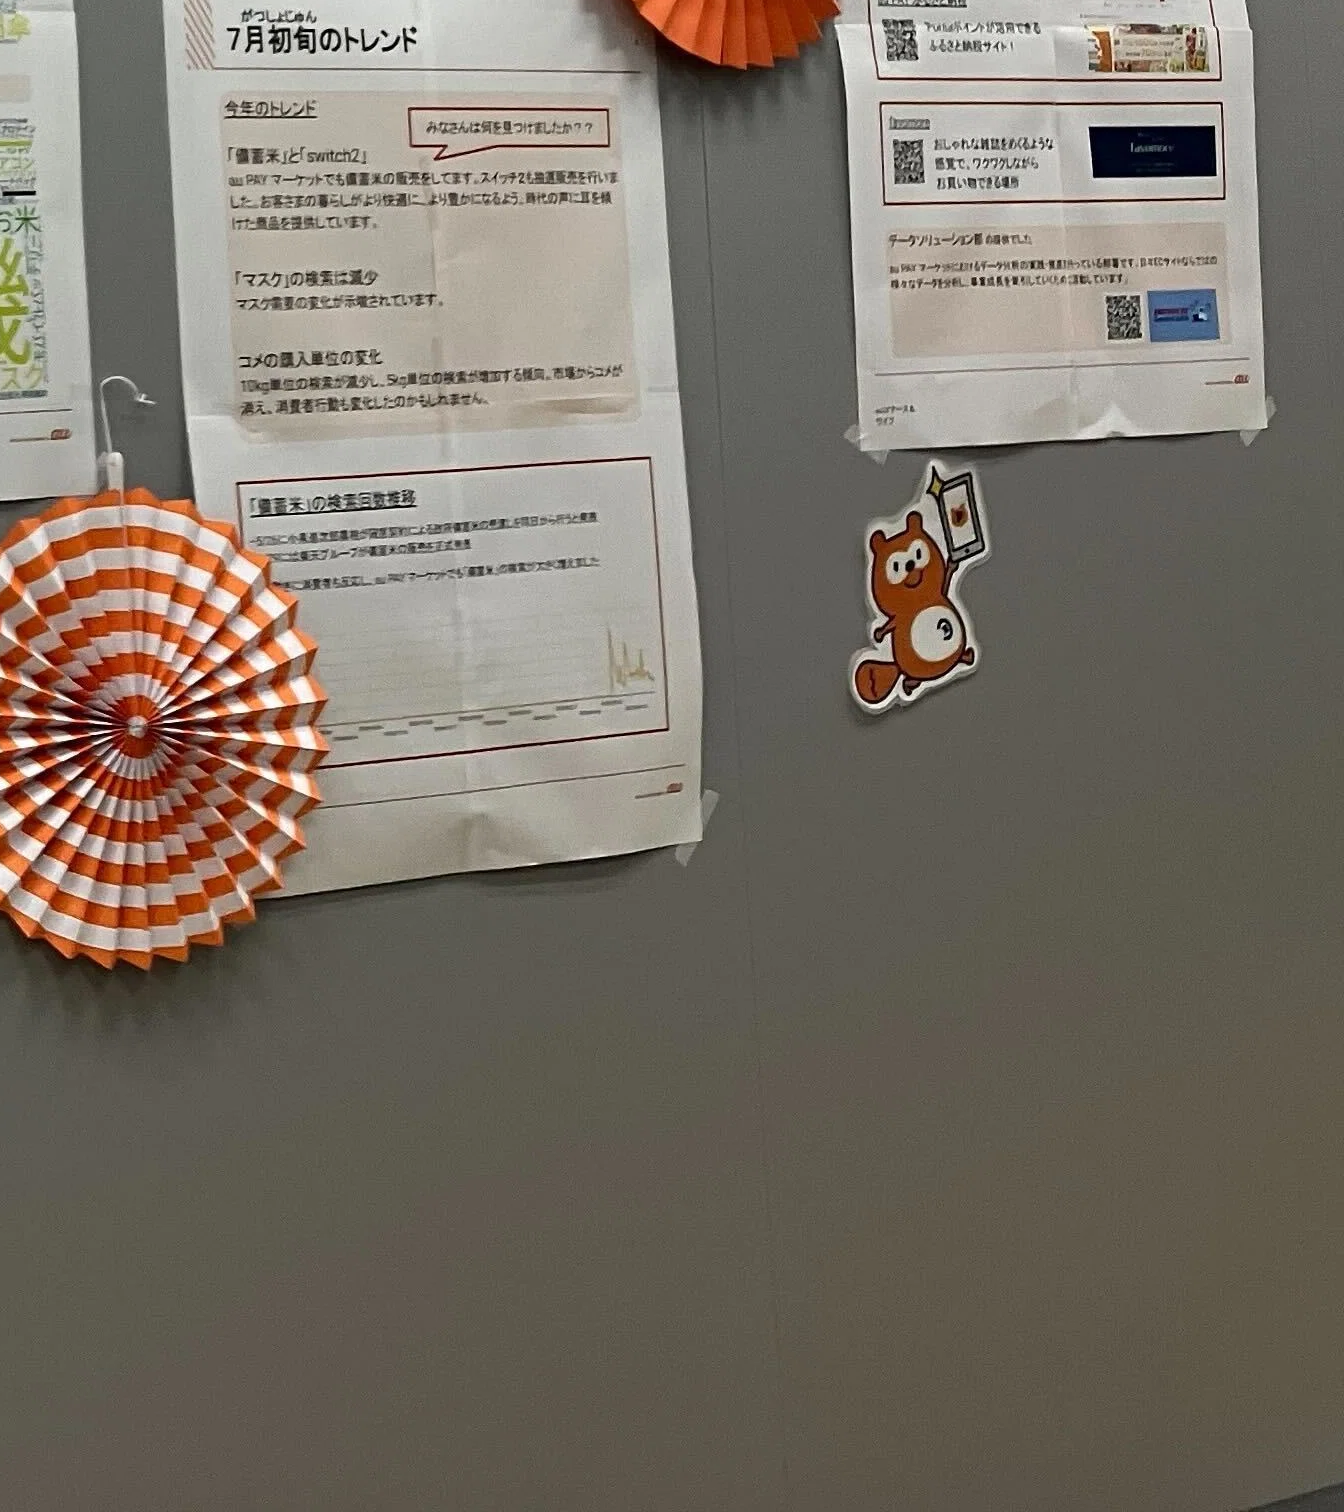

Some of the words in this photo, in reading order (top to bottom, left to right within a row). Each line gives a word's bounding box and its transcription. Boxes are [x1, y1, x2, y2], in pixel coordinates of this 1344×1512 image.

[226, 25, 418, 54] 7月初旬のトレンド
[225, 99, 317, 116] 今年のトレンド
